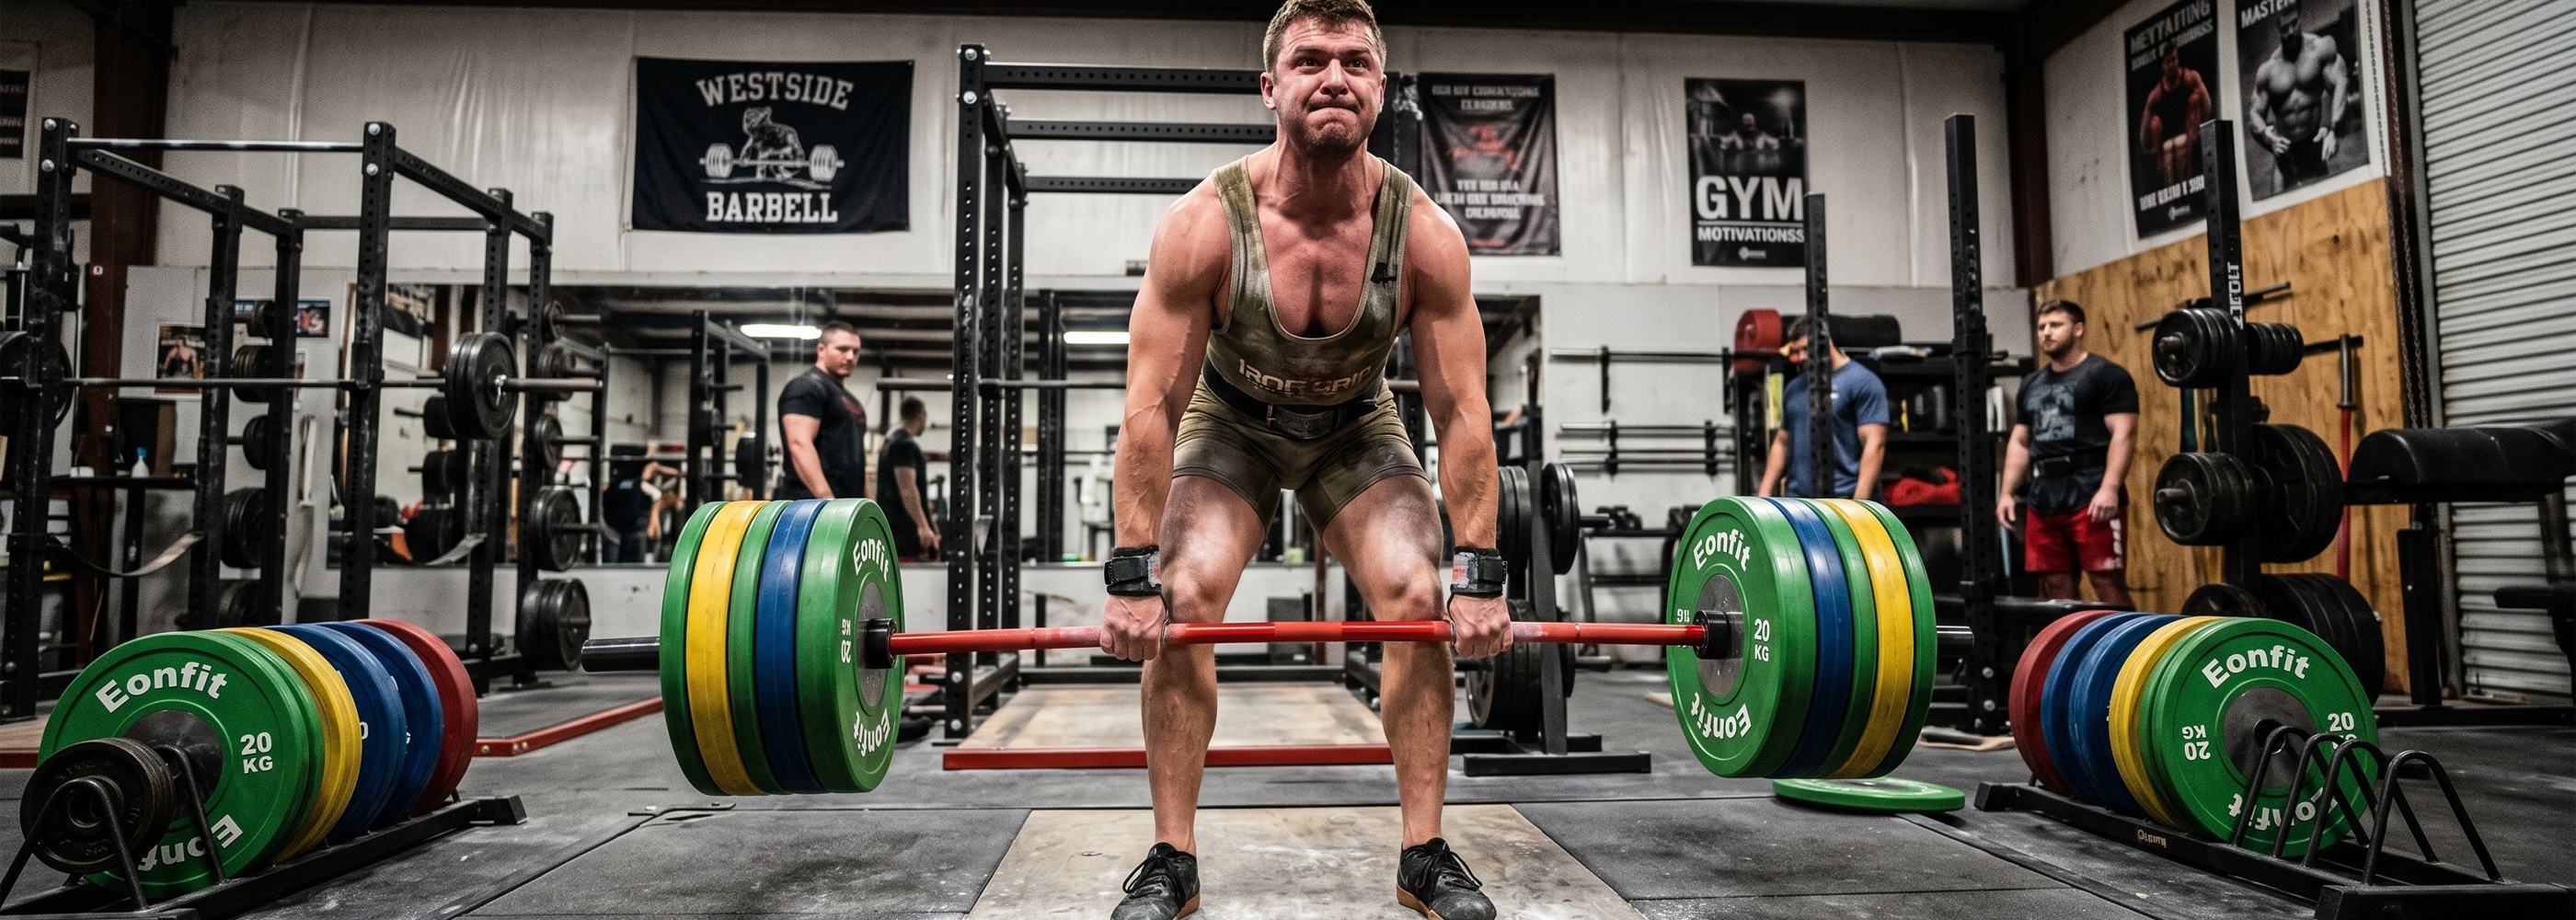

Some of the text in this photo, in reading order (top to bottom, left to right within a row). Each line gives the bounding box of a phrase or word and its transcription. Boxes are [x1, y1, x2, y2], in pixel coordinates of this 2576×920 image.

[696, 72, 854, 110] WESTSIDE
[706, 191, 838, 223] BARBELL
[1696, 175, 1804, 221] GYM
[1697, 226, 1804, 243] MOTIVATIONSS
[853, 538, 890, 582] Eonfit
[1693, 529, 1751, 572] Eonfit
[1754, 618, 1770, 642] 20
[841, 639, 852, 663] 20
[1754, 645, 1769, 661] KG
[2202, 644, 2310, 689] Eonfit
[95, 661, 227, 713] Eonfit
[853, 707, 891, 757] Eonfit
[1690, 692, 1752, 740] Eonfit
[2181, 724, 2206, 740] KG
[2327, 712, 2354, 732] 20
[240, 732, 272, 755] 20
[2184, 741, 2211, 761] 20
[243, 756, 273, 774] KG
[138, 814, 244, 871] Eonf
